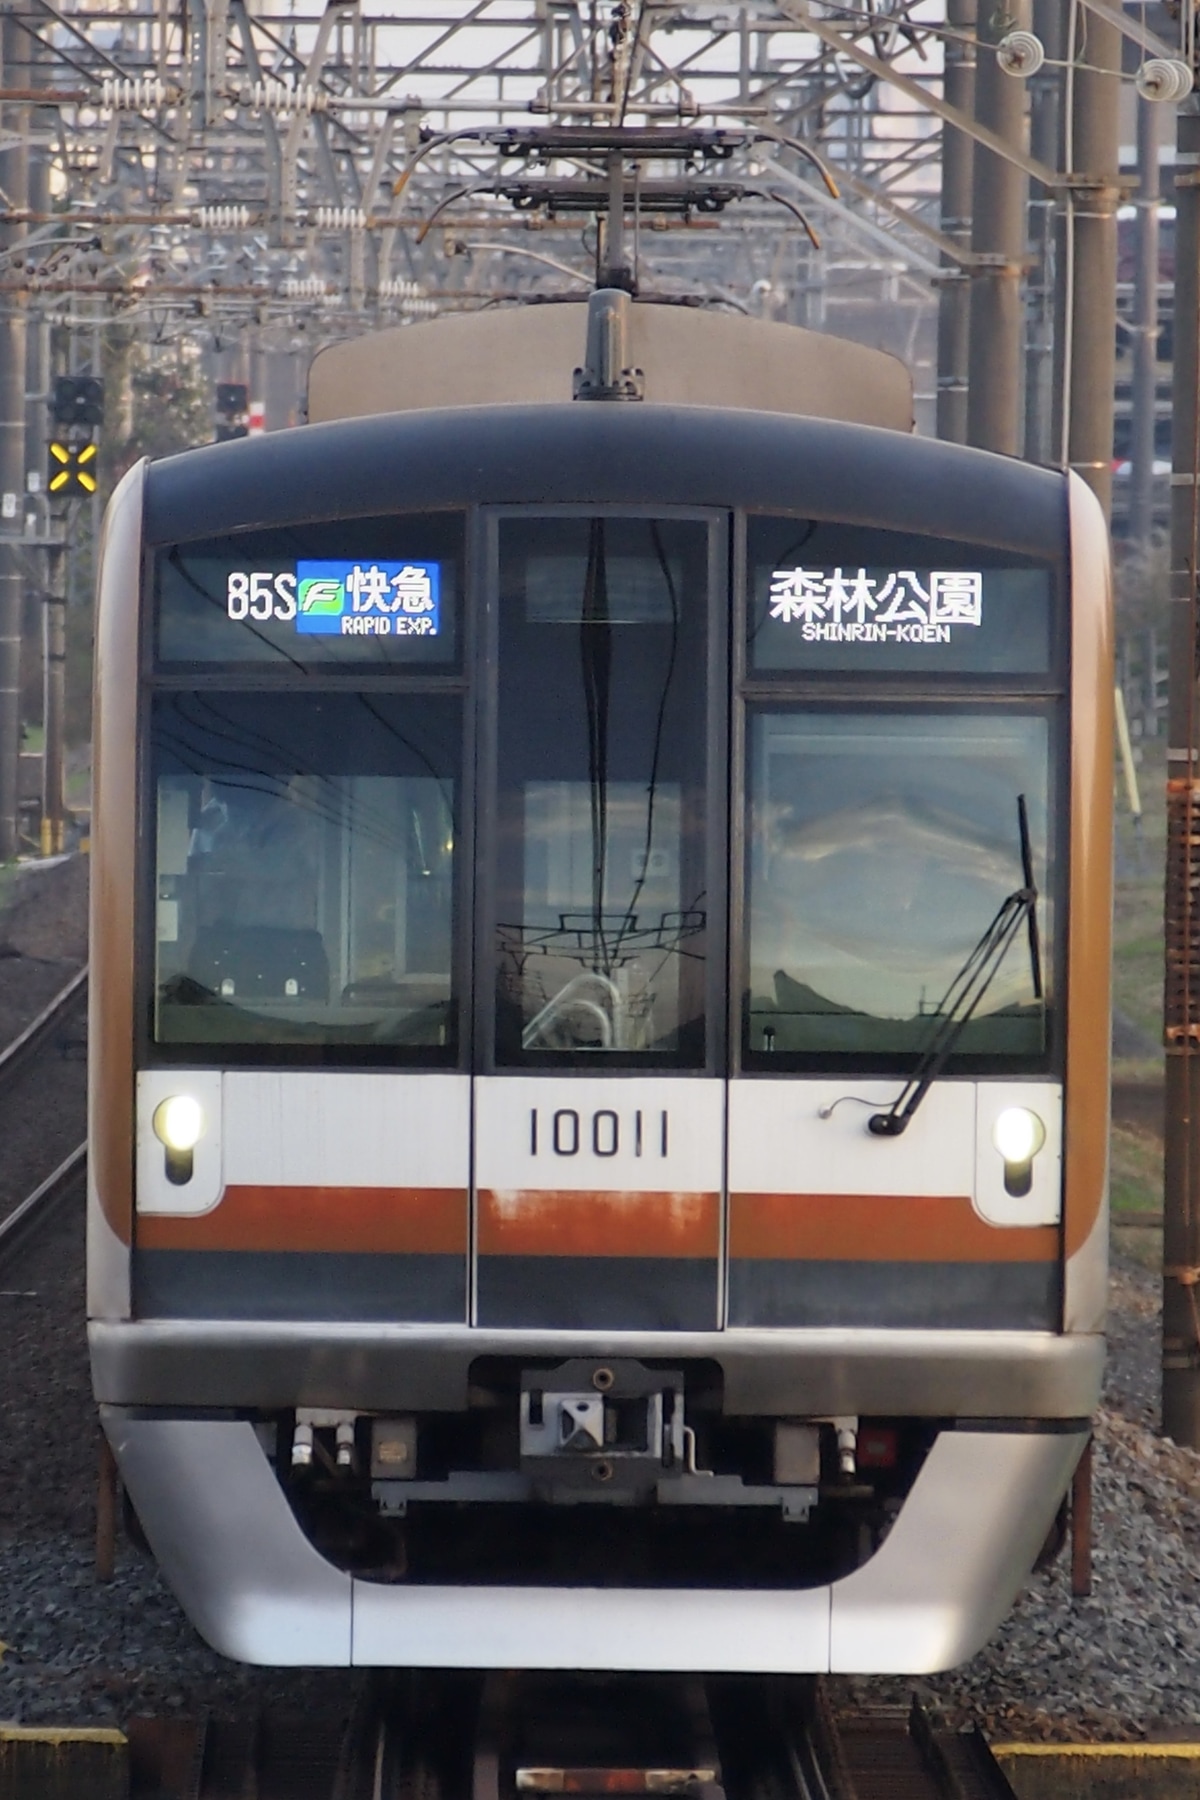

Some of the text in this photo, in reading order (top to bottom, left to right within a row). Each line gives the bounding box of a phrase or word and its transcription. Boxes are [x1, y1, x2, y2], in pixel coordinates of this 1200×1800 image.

[227, 572, 297, 621] 85S
[346, 565, 435, 613] 快急
[769, 567, 983, 626] 森林公園
[341, 616, 437, 635] RAPID EXP.
[801, 622, 951, 643] SHINRIN-KOEN
[530, 1108, 668, 1158] 10011
